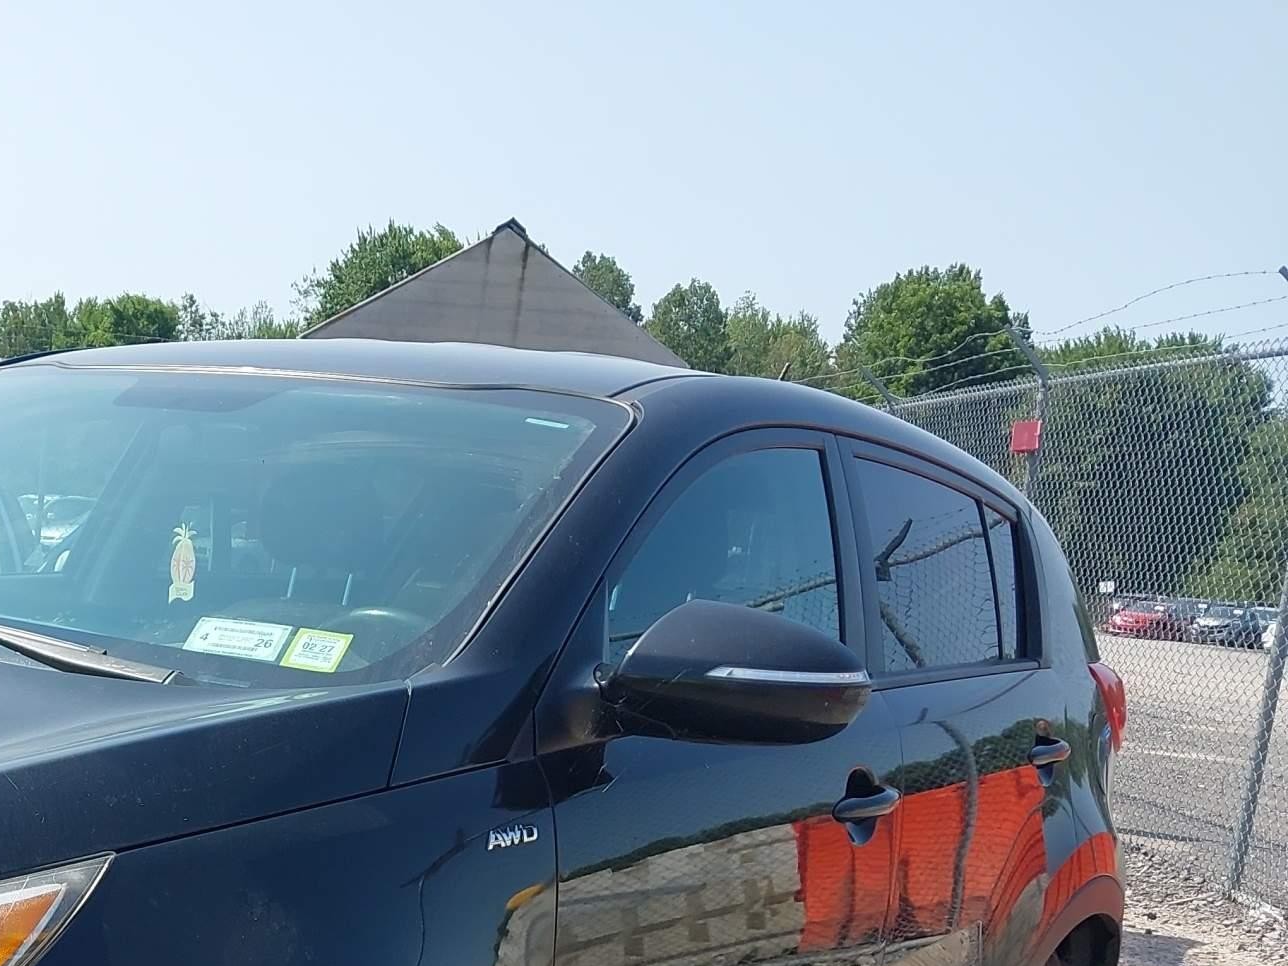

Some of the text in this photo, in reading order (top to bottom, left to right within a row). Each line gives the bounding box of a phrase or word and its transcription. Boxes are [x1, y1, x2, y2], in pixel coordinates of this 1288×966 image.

[255, 638, 273, 648] 26
[303, 641, 335, 653] 02 27
[488, 825, 538, 851] AWD
